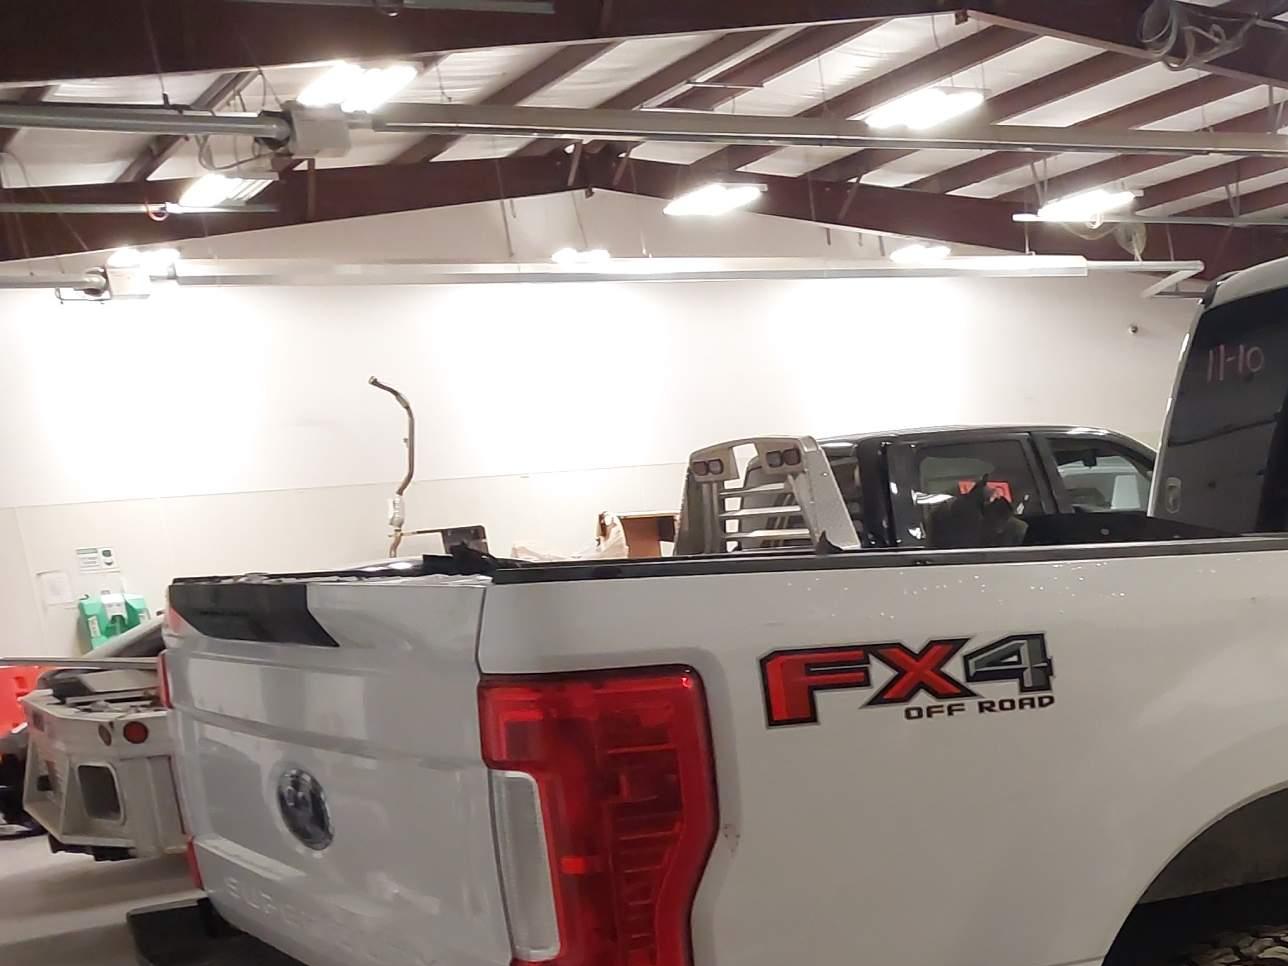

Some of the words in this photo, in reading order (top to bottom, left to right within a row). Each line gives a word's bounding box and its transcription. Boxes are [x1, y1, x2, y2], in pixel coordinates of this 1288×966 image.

[1207, 344, 1264, 383] 11-10
[760, 633, 1054, 728] FX4
[904, 702, 966, 720] OFF
[977, 695, 1055, 714] ROAD
